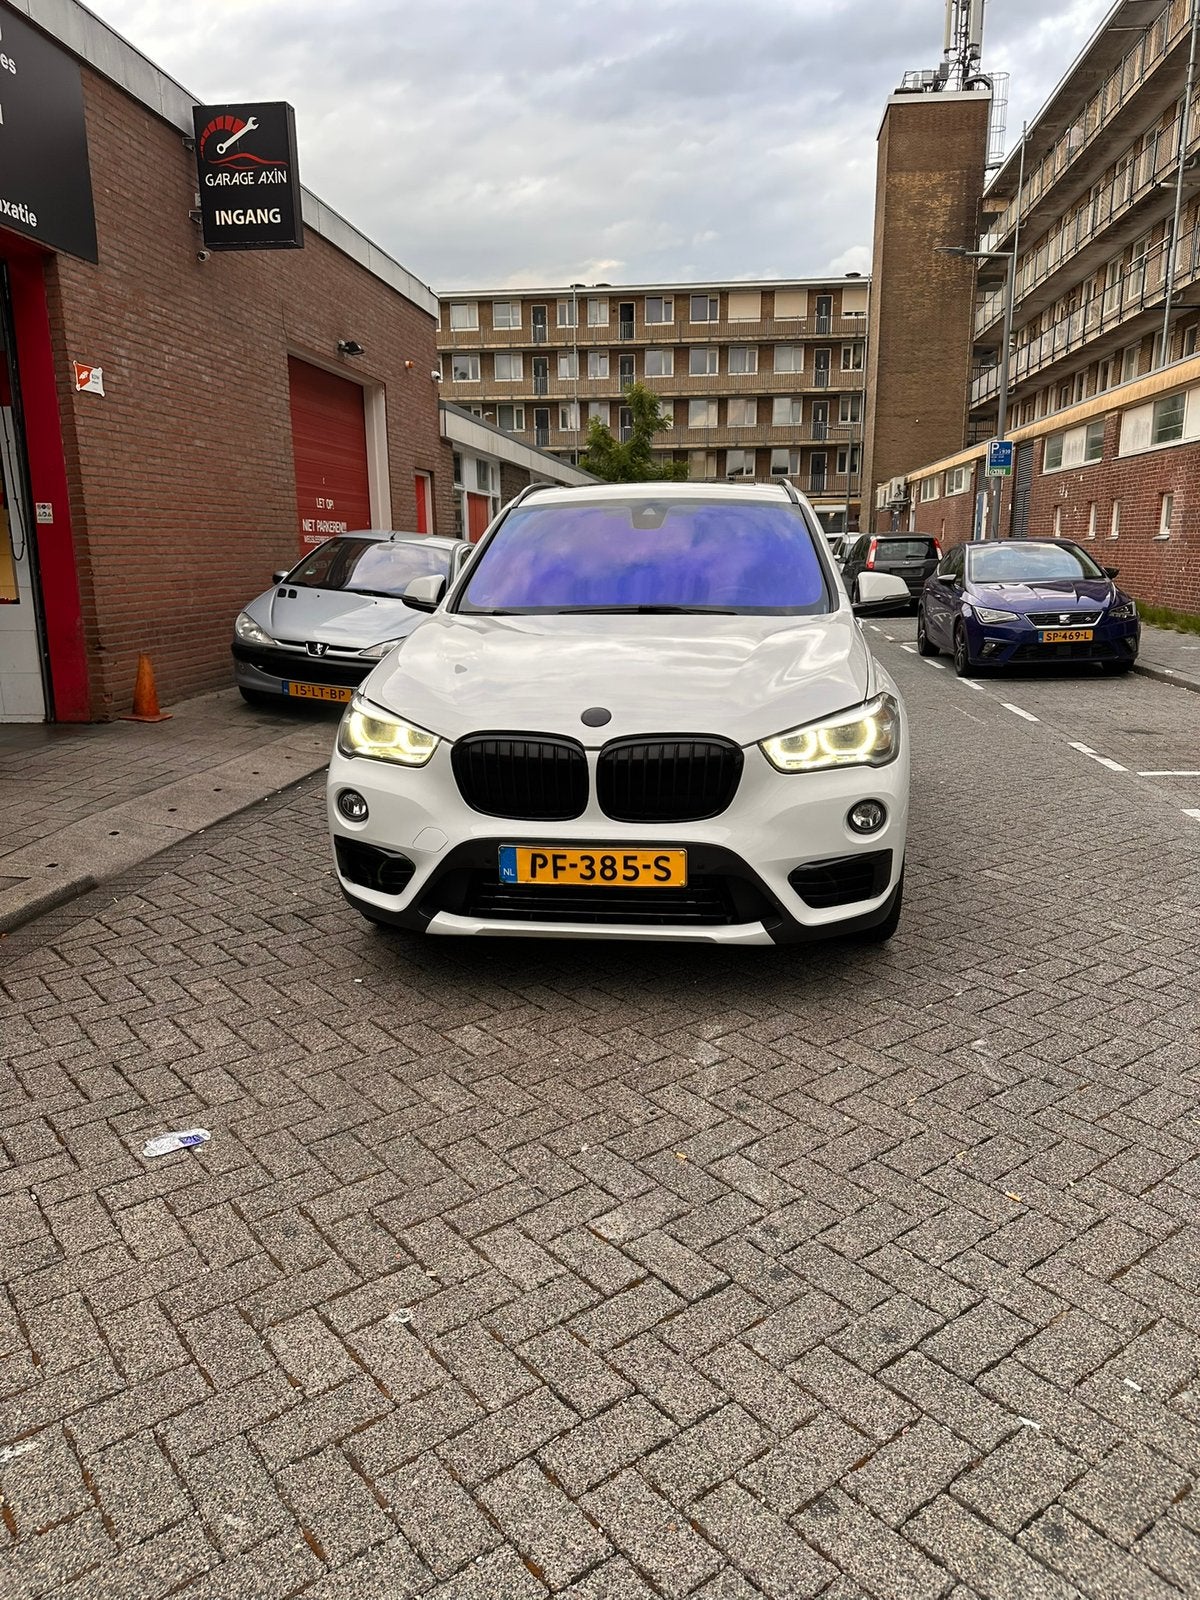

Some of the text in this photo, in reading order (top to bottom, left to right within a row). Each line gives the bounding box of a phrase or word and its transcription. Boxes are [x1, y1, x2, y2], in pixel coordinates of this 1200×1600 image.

[205, 171, 255, 187] GARAGE
[215, 208, 281, 225] INGANG
[991, 442, 1000, 454] P
[315, 497, 325, 509] LET
[302, 518, 316, 532] NIET
[1046, 631, 1089, 641] SP-469-L
[294, 684, 346, 700] 15-LT-BP
[503, 868, 515, 876] NL
[530, 853, 672, 882] PF-385-S
